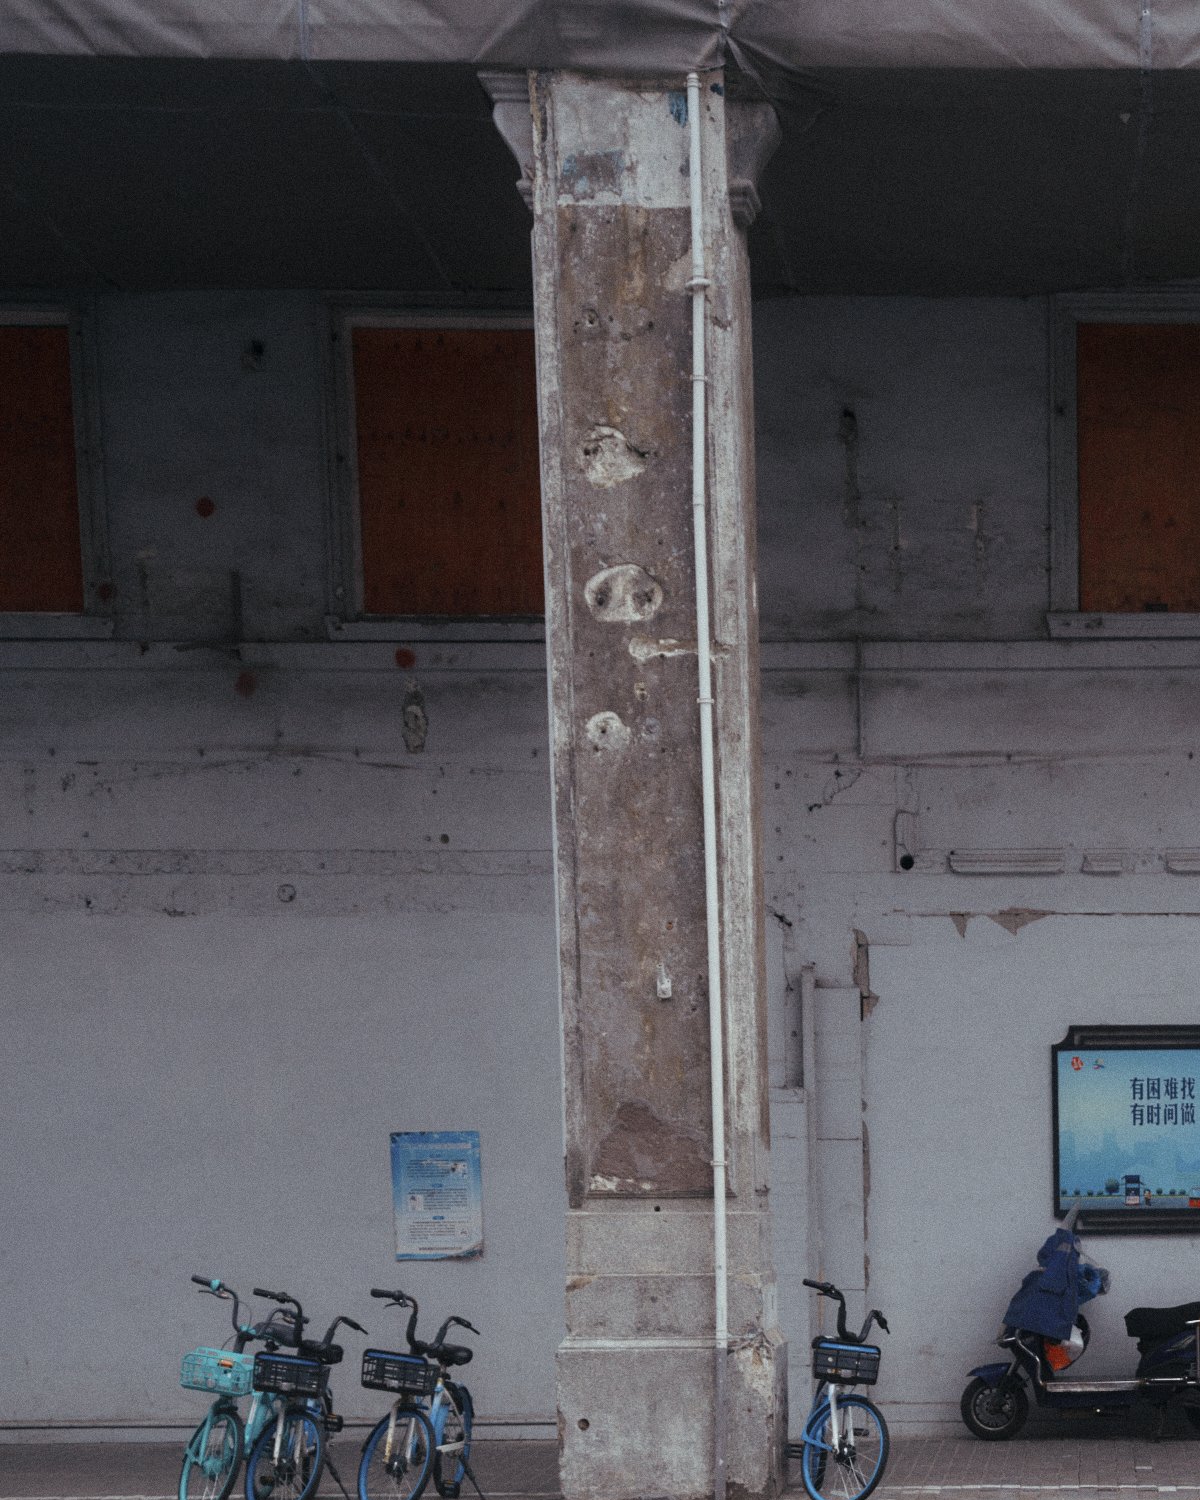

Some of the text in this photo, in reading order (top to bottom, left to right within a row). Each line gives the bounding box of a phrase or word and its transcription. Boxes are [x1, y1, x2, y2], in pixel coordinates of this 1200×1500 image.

[1130, 1077, 1195, 1100] 有困难找
[1130, 1103, 1195, 1126] 有时间做
